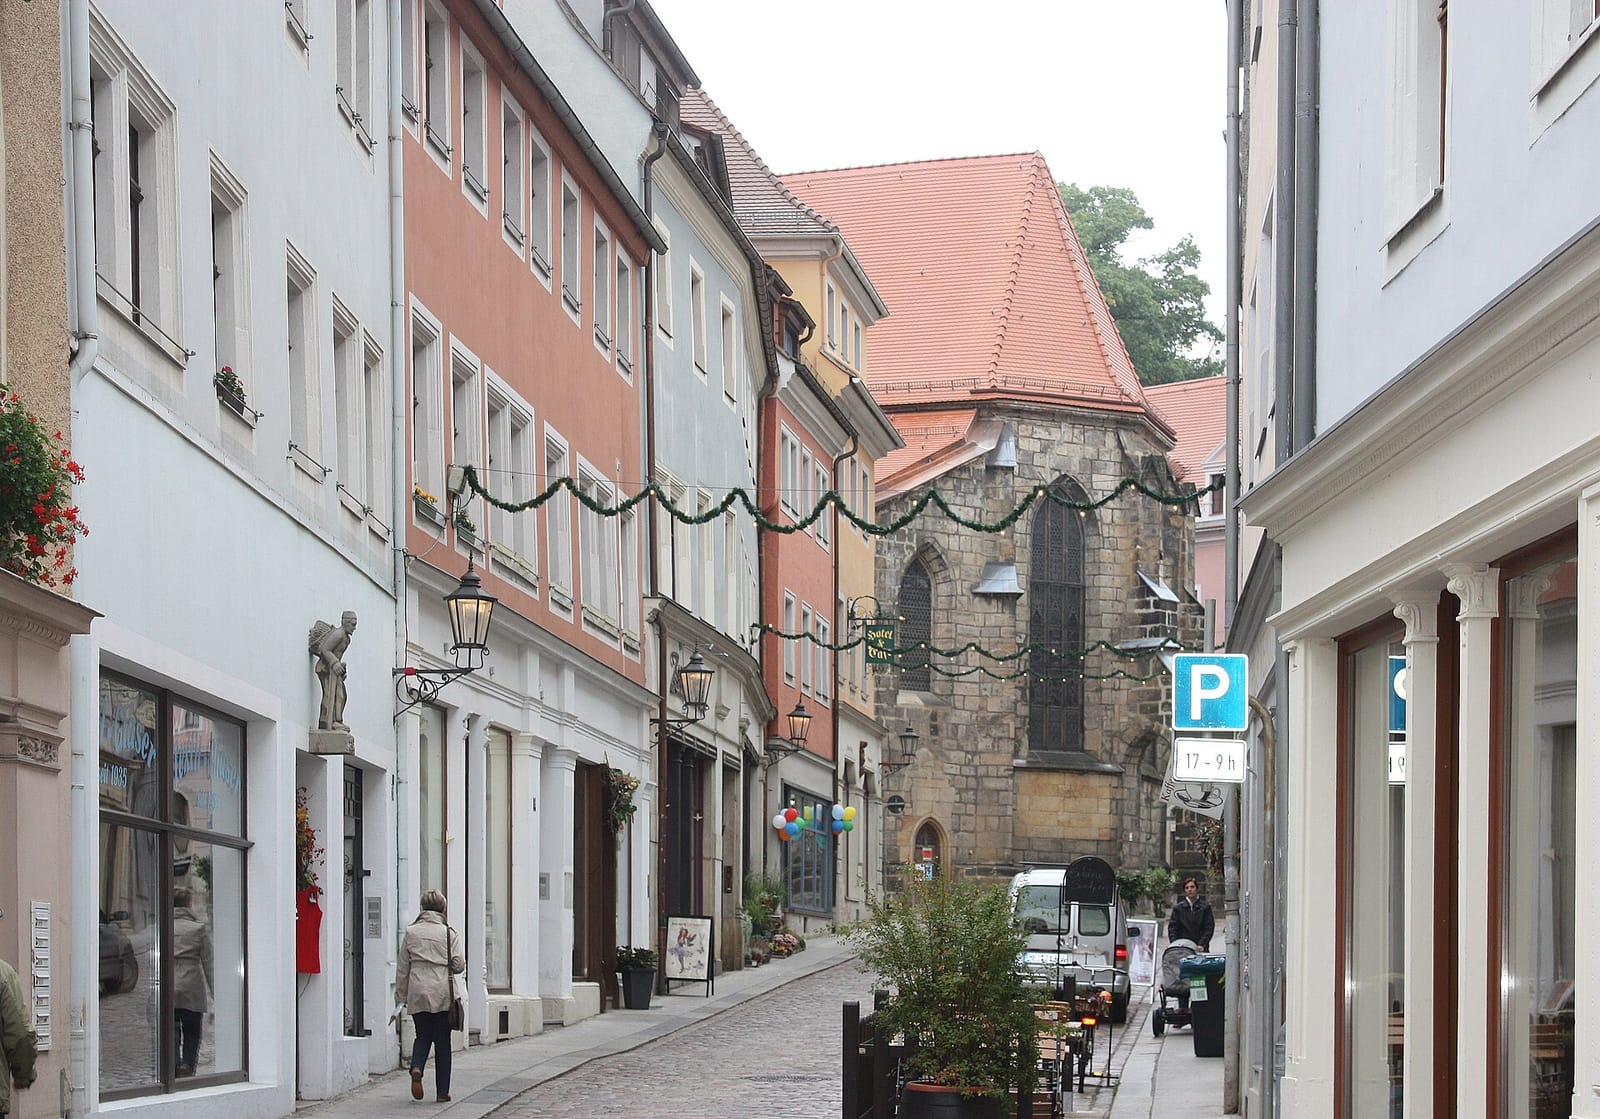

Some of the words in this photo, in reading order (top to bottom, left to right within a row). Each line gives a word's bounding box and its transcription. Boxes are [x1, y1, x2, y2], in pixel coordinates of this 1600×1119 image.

[867, 629, 893, 640] Hotel
[878, 639, 885, 648] &
[1190, 664, 1230, 720] P
[1186, 753, 1199, 769] 17
[1228, 755, 1235, 771] h
